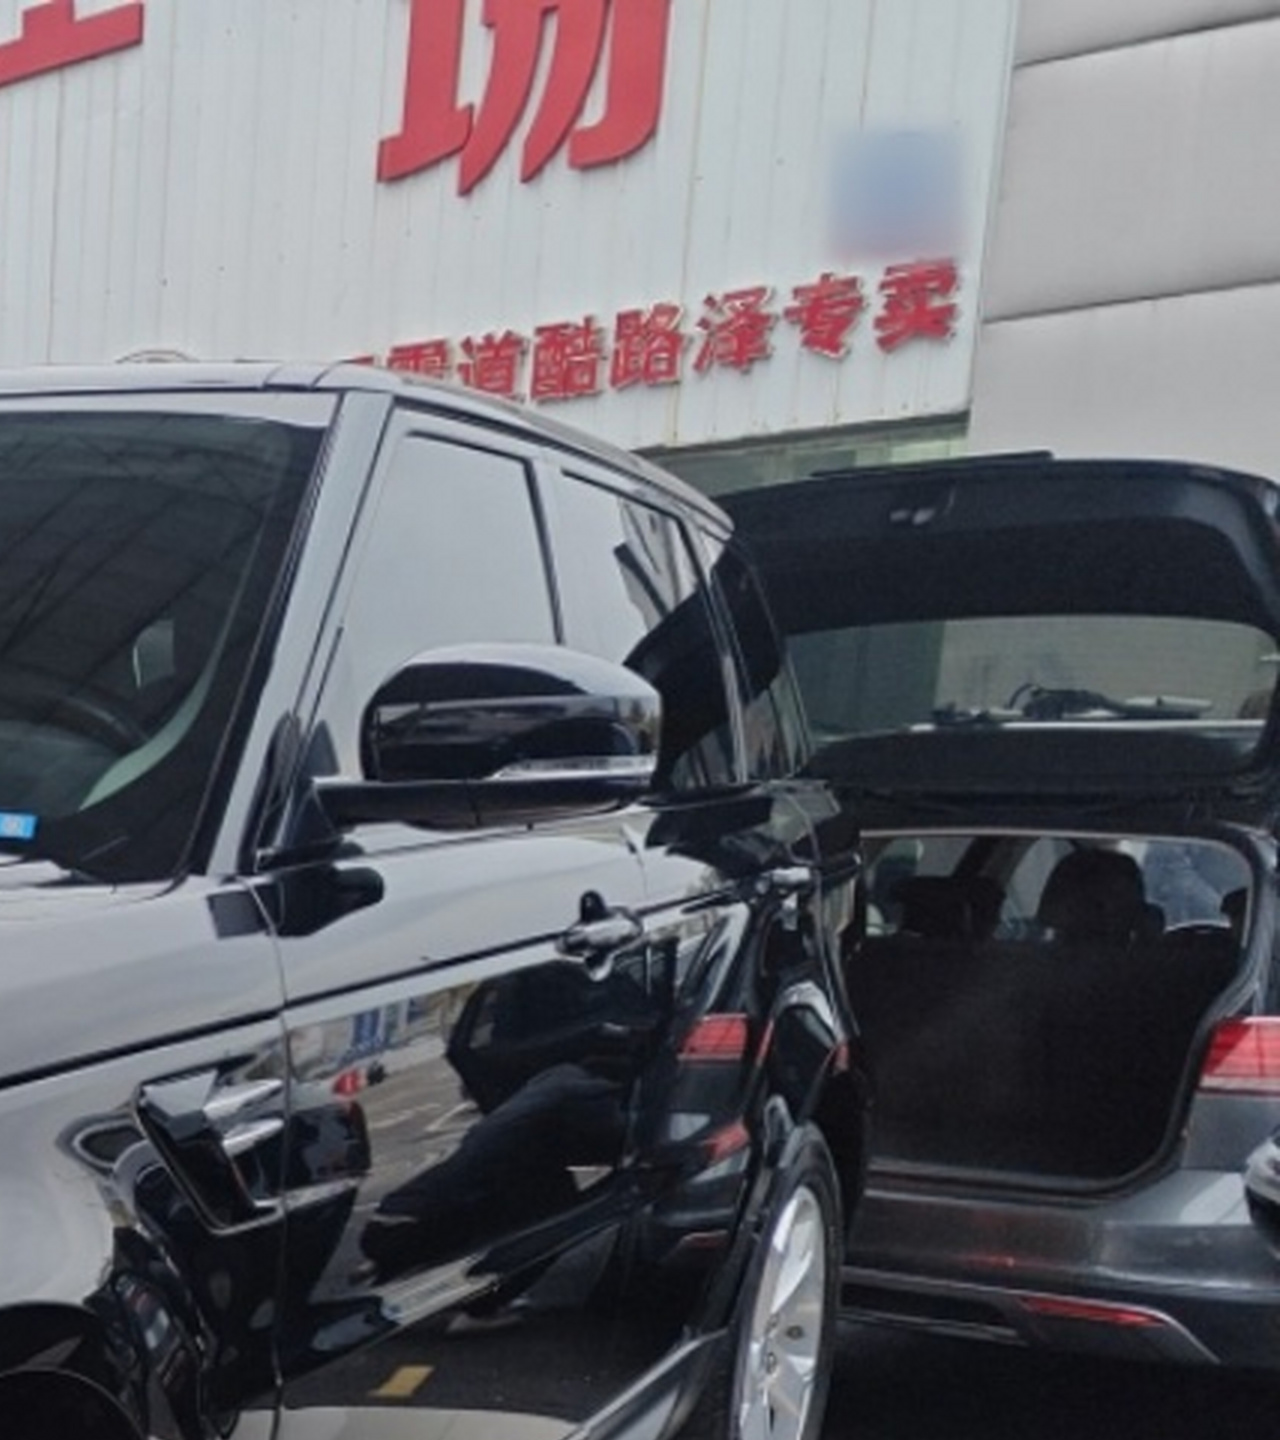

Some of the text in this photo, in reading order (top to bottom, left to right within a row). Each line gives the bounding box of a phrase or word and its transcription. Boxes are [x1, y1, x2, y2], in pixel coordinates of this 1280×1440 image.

[342, 256, 960, 404] 道酷路泽专卖
